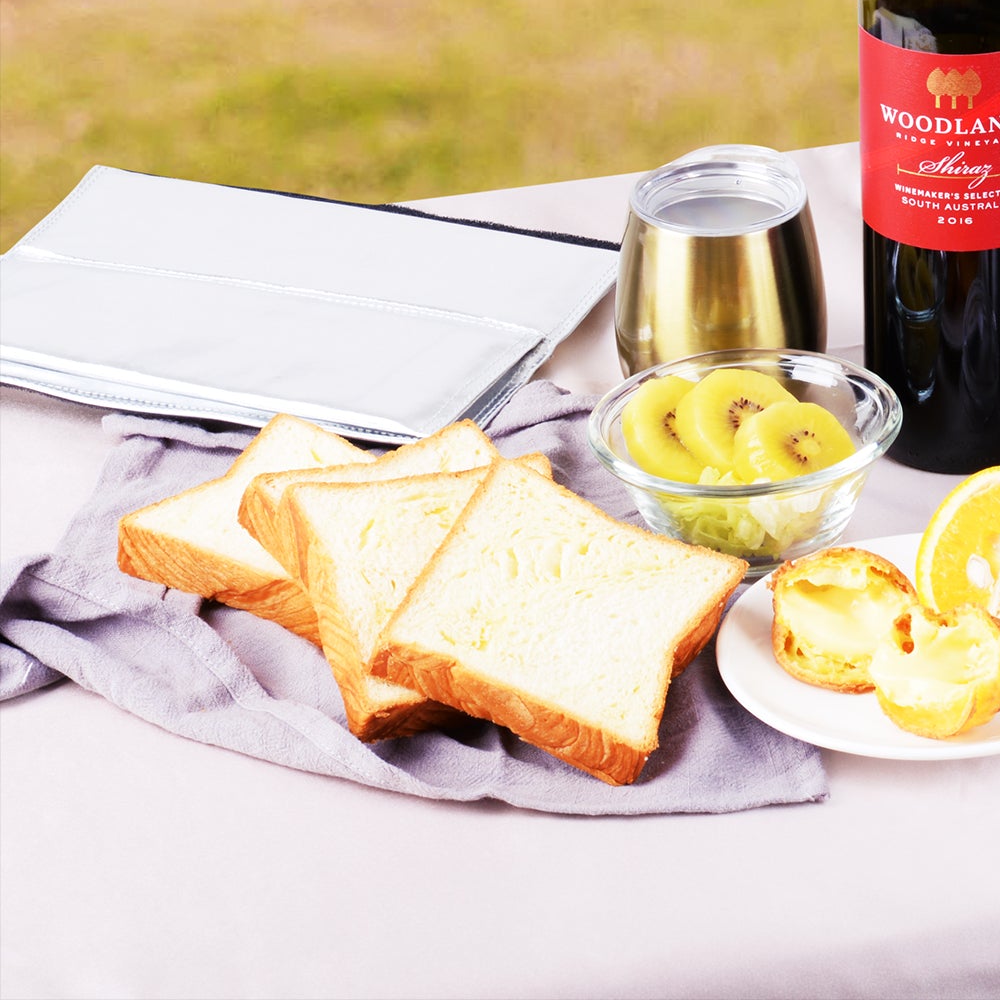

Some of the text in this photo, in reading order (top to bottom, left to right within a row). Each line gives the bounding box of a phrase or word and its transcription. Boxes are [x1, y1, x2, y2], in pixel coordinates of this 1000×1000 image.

[895, 132, 936, 146] RIDGE
[918, 151, 993, 189] Shiraz
[894, 183, 960, 200] WINEMAKER'S
[901, 196, 941, 210] SOUTH
[937, 216, 973, 225] 2016
